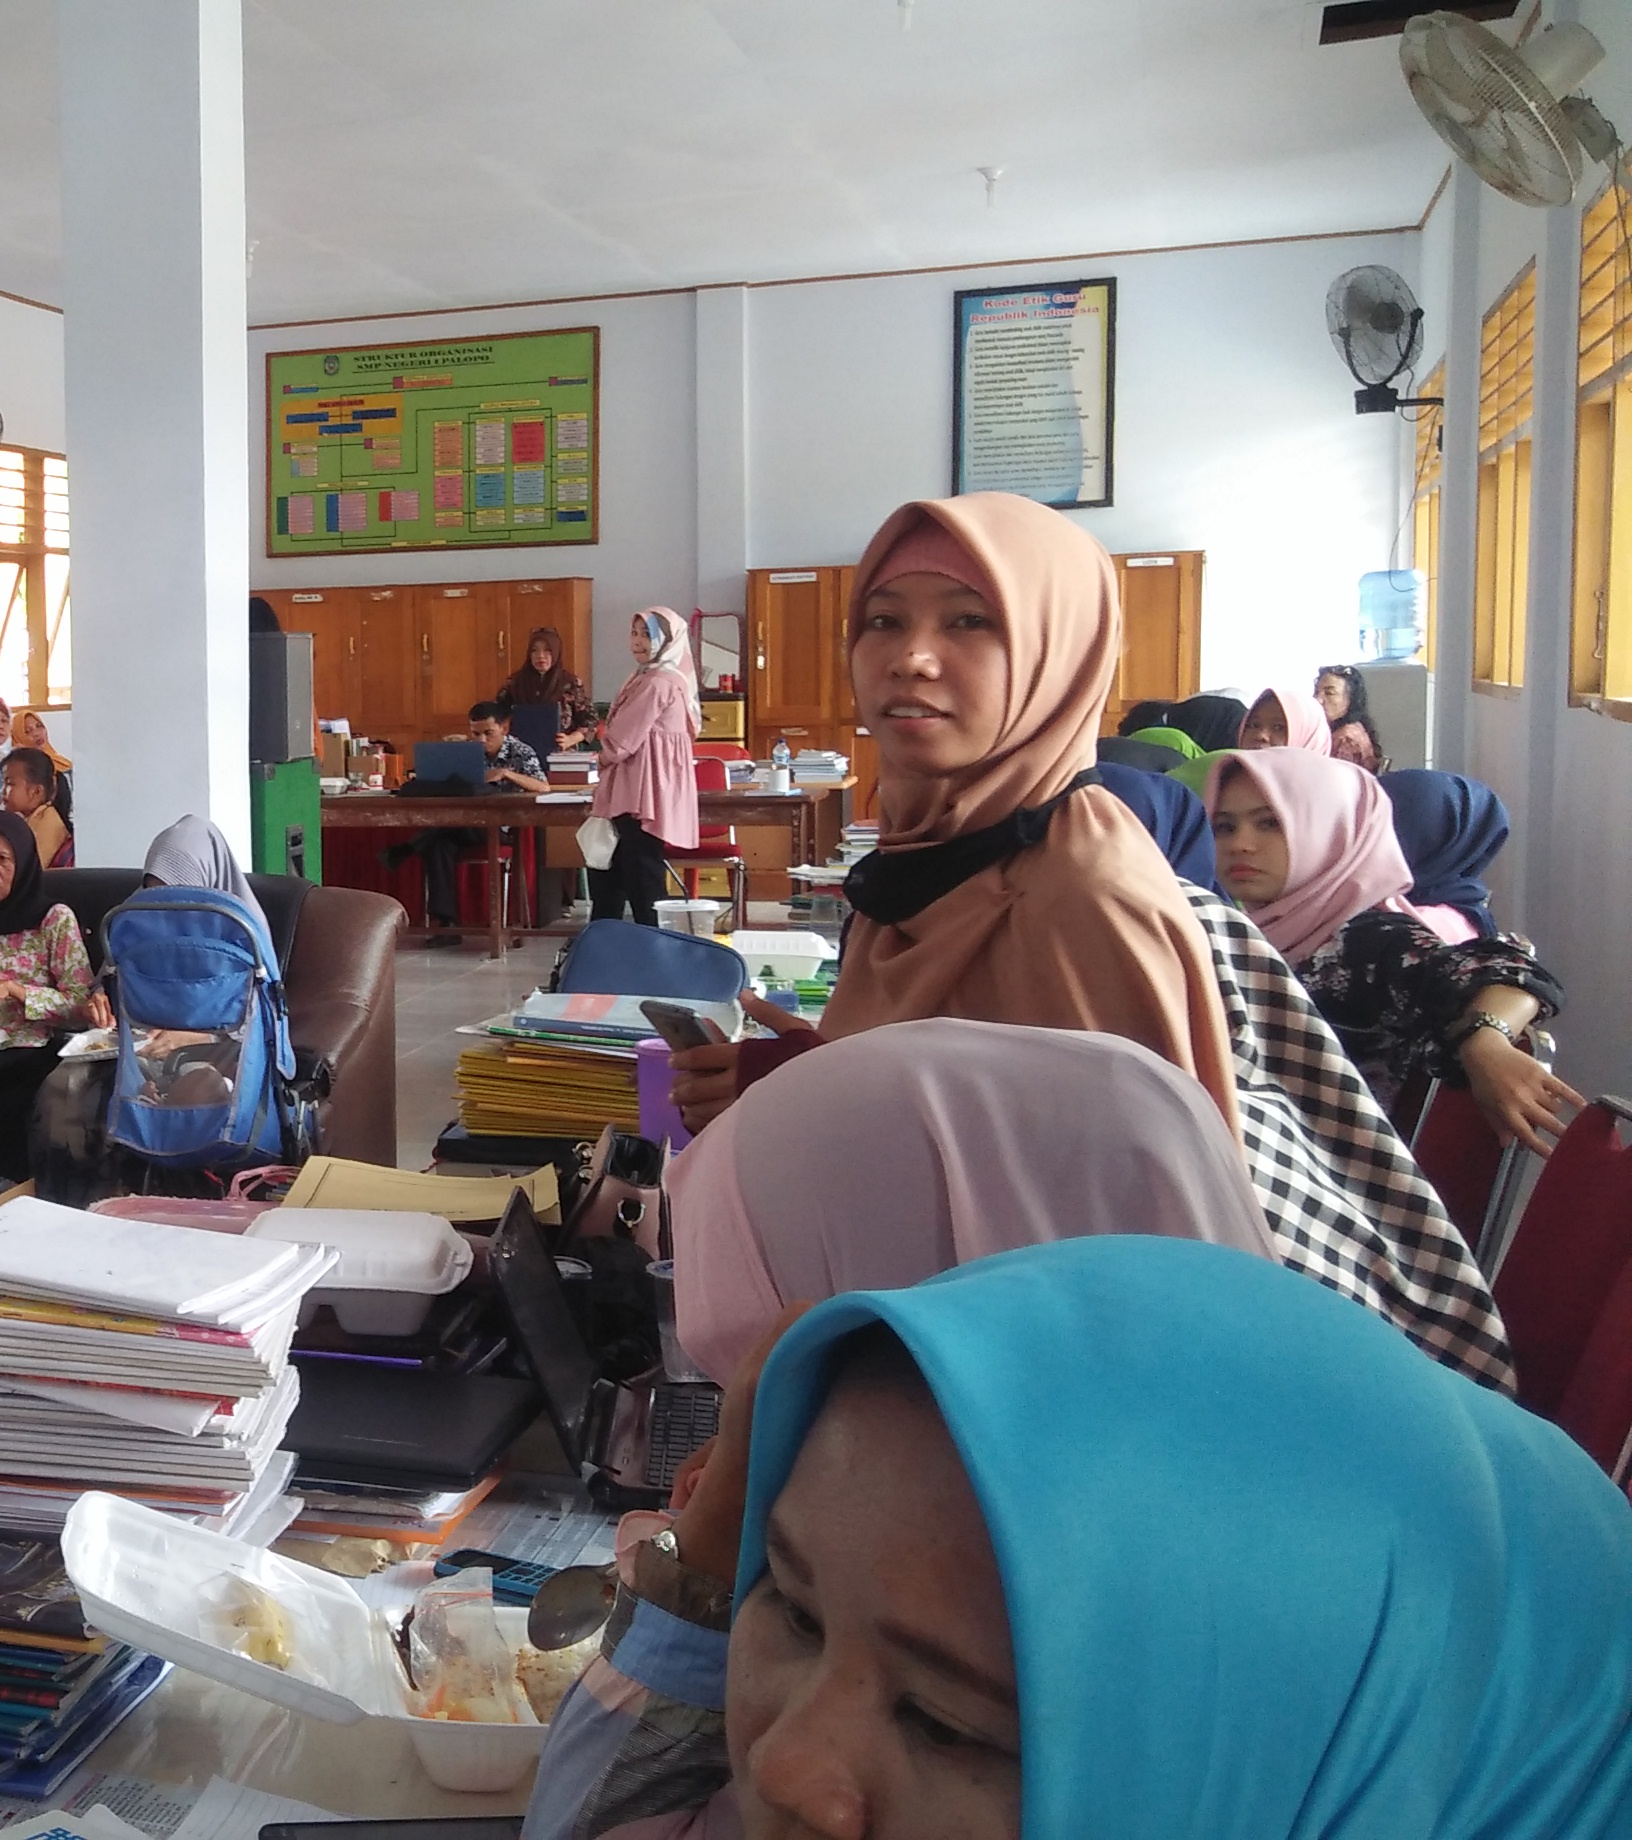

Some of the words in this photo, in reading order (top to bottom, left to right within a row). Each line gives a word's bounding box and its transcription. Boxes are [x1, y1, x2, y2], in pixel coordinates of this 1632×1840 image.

[984, 299, 1018, 308] Kode
[1022, 295, 1050, 305] Etik
[1052, 293, 1086, 304] Guru
[970, 311, 1028, 323] Republik
[1033, 306, 1099, 318] Indonesia
[420, 346, 493, 357] ORGANISASI
[357, 362, 382, 370] SMP
[385, 359, 431, 369] NEGERI
[442, 355, 490, 365] PALOPO
